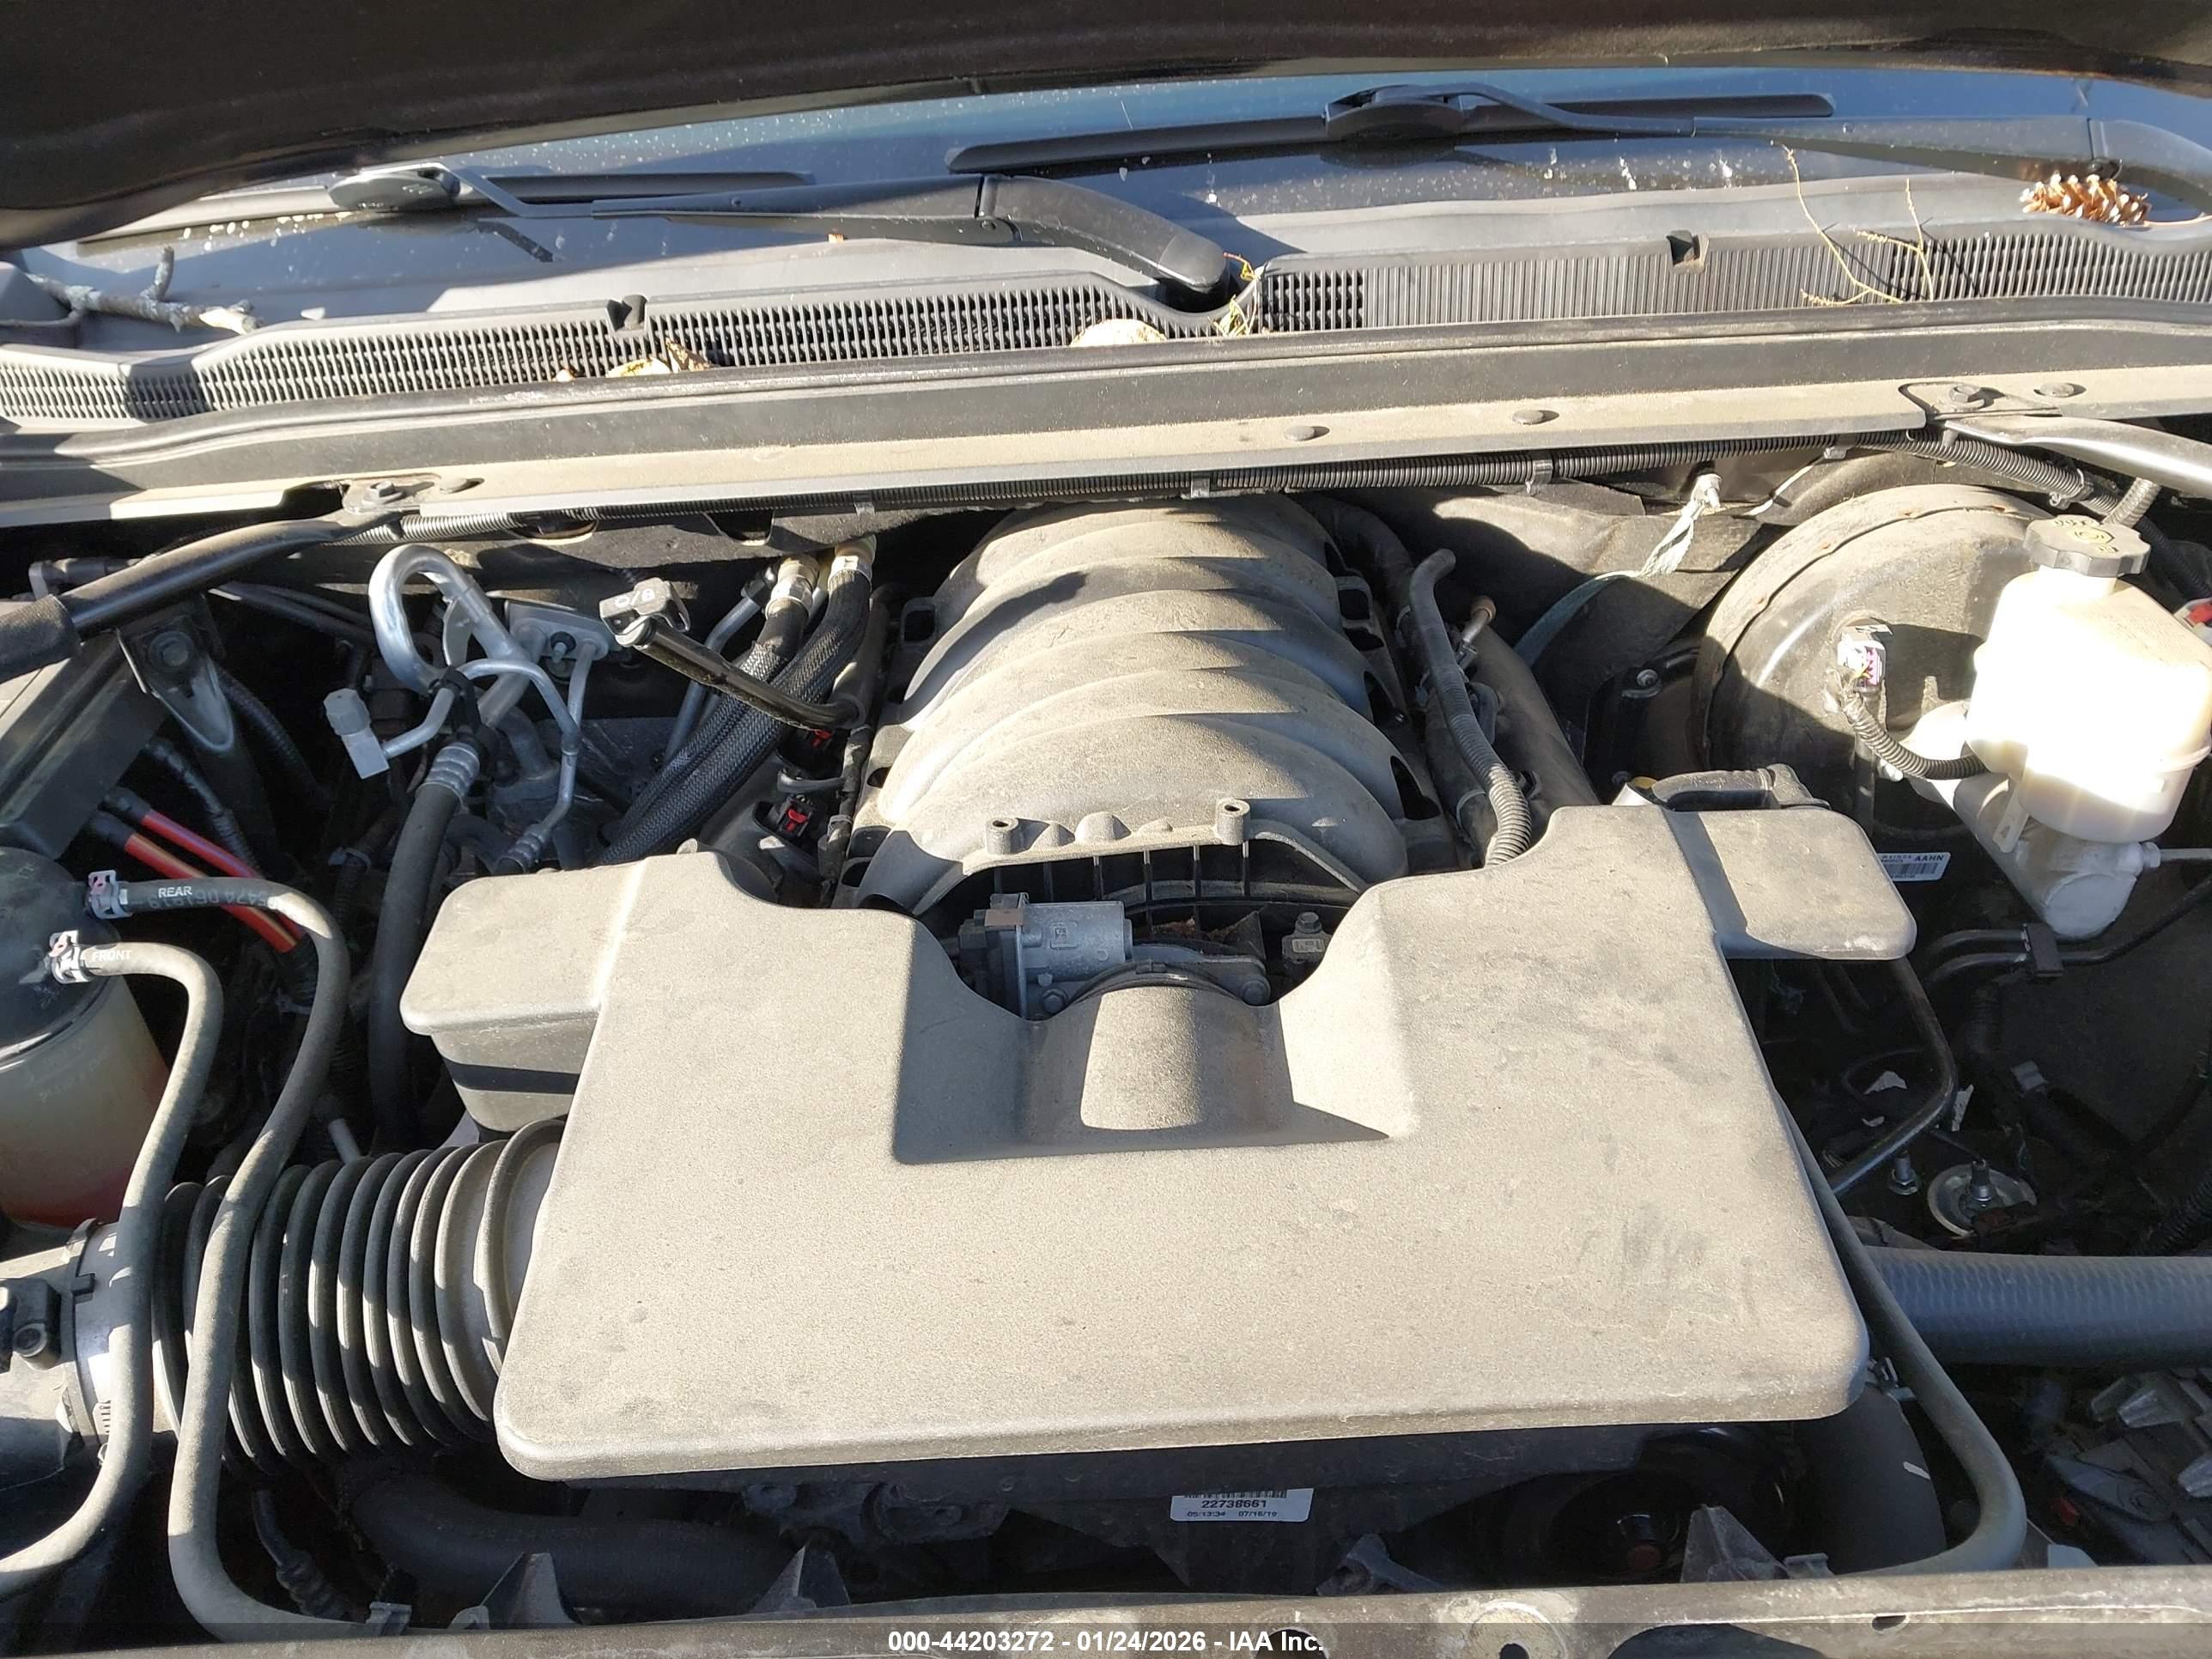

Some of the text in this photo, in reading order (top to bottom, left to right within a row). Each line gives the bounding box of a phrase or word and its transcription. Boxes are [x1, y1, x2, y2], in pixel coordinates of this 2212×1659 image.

[158, 885, 193, 898] REAR
[92, 949, 132, 963] FRONT
[1201, 1499, 1267, 1509] 22738661
